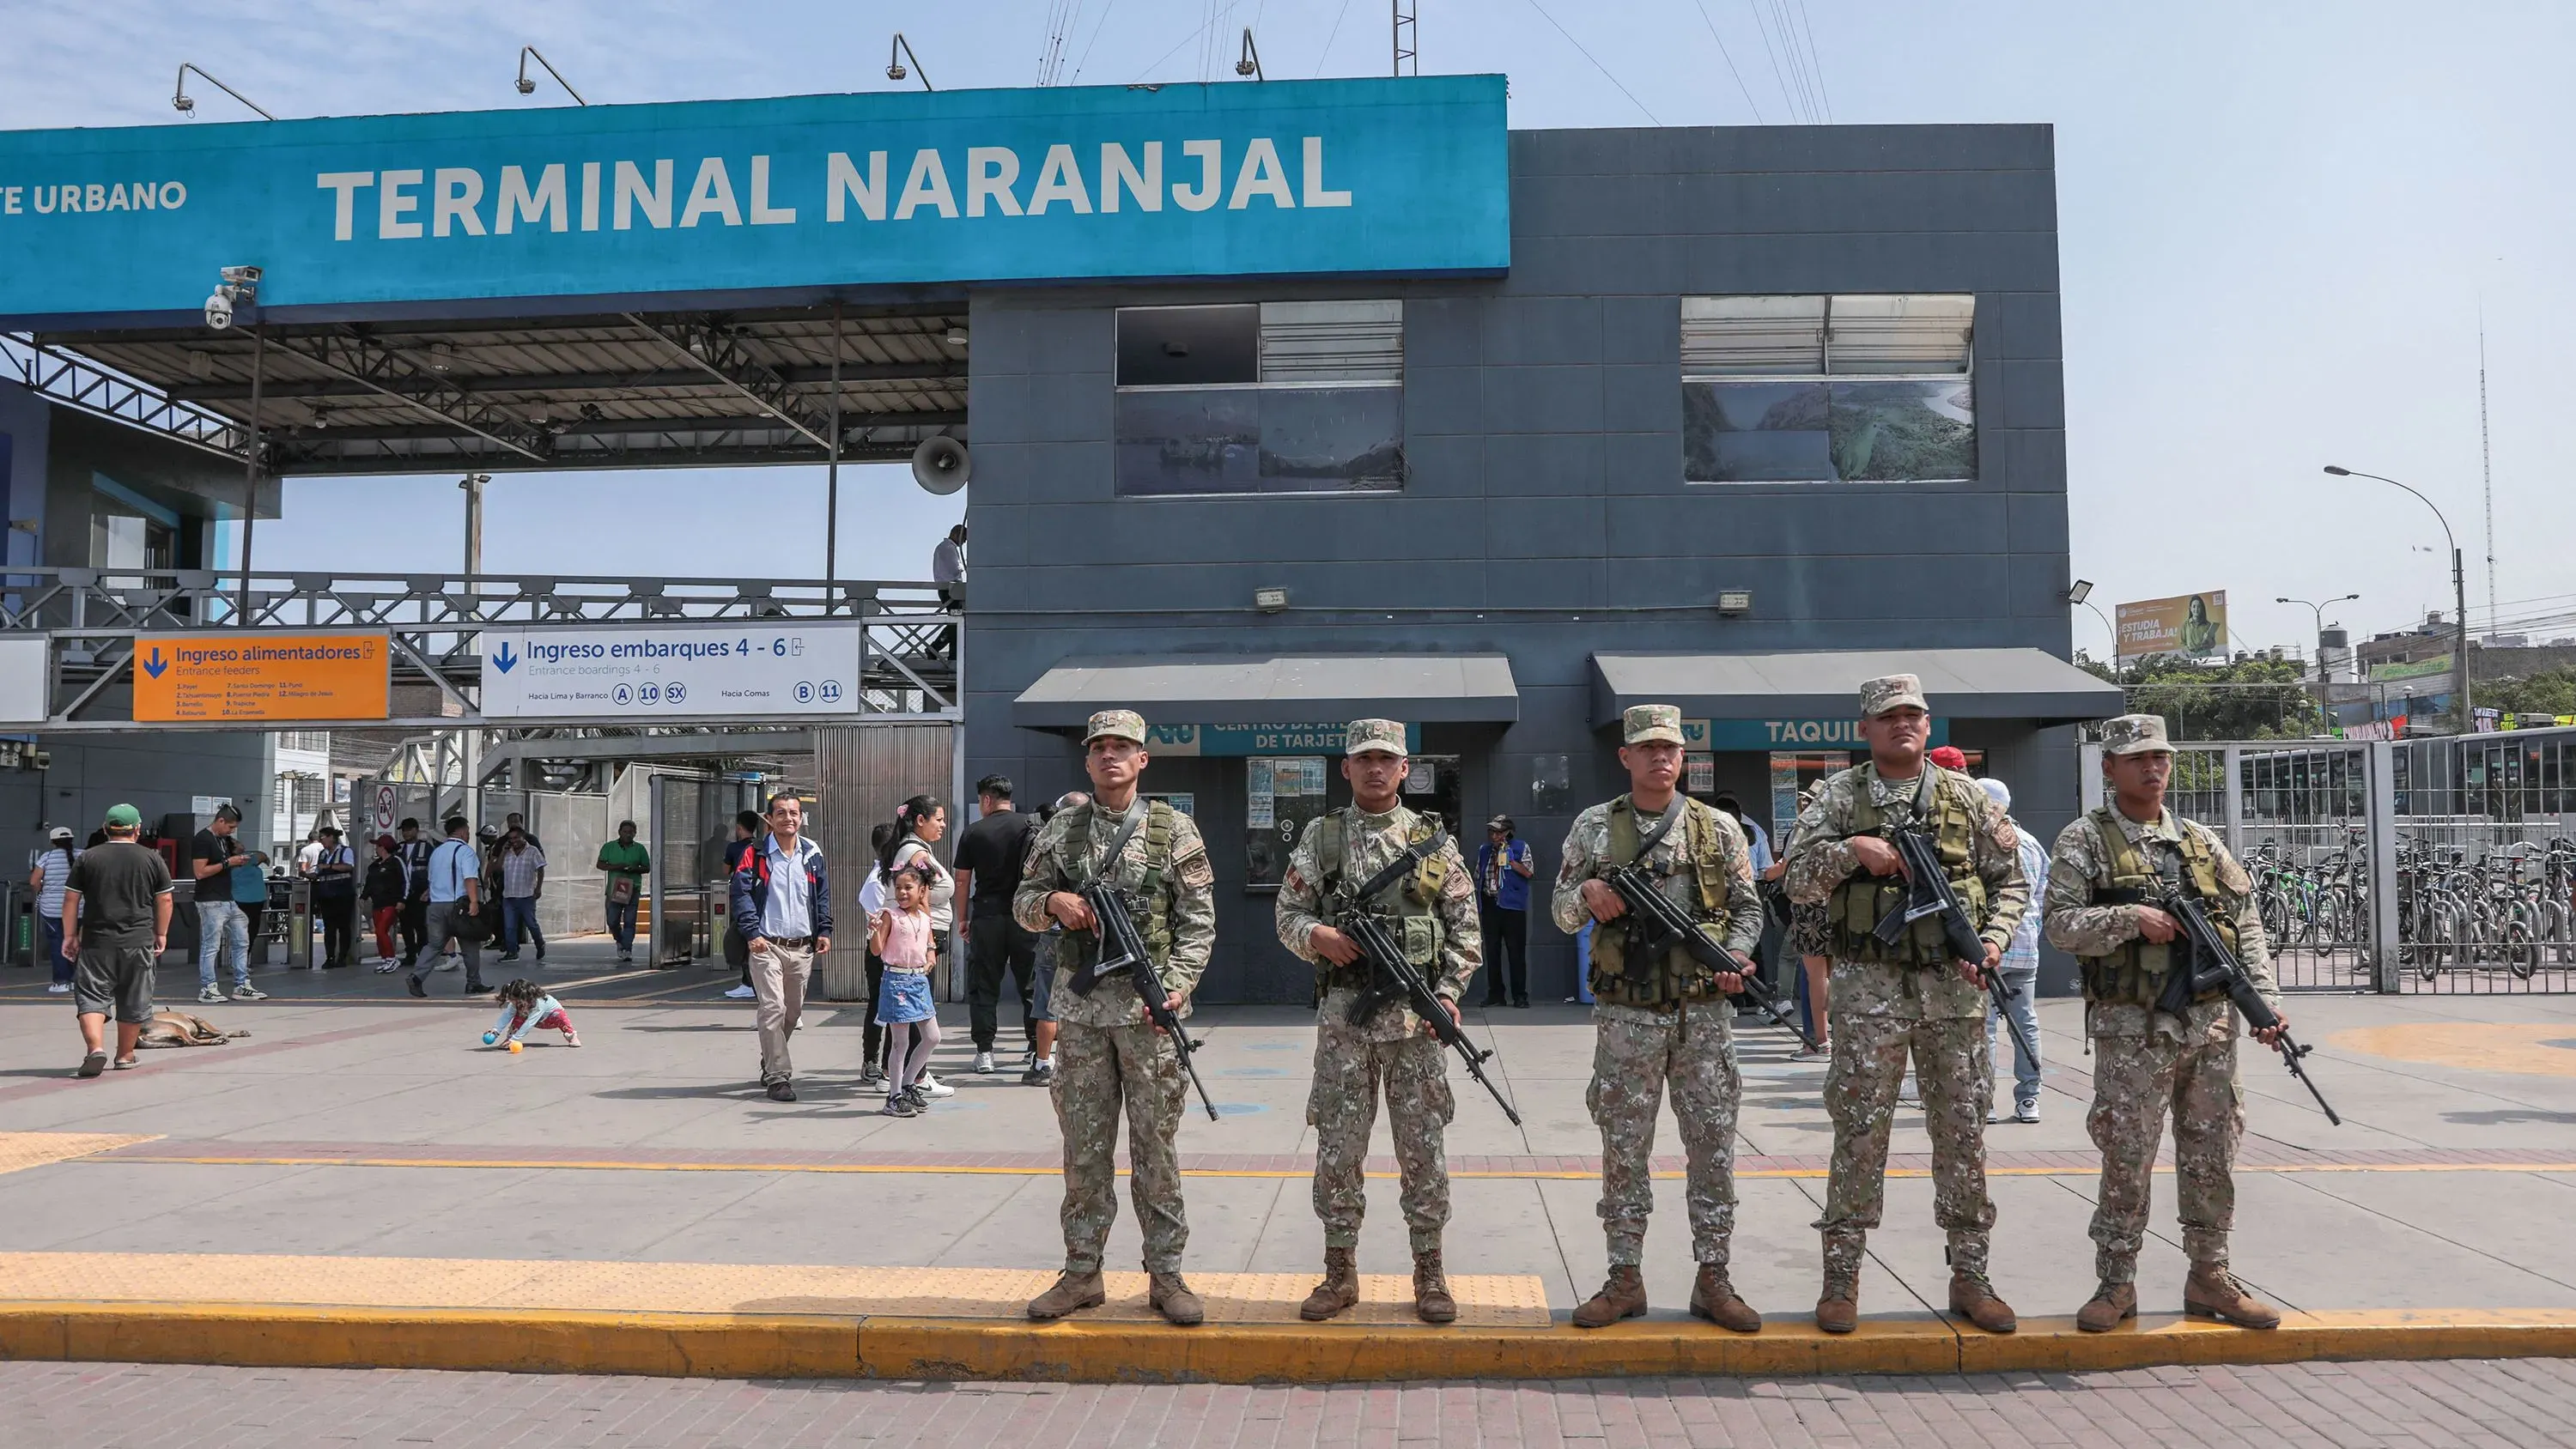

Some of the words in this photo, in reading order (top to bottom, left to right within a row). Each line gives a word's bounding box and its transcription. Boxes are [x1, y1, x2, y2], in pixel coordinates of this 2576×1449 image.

[317, 155, 797, 241] TERMINAL
[826, 136, 1352, 222] NARANJAL
[0, 186, 23, 215] E
[34, 180, 187, 214] URBANO
[2123, 633, 2131, 643] Y
[2132, 627, 2178, 642] TRABAJA!
[177, 646, 238, 665] Ingreso
[243, 645, 361, 660] alimentadores
[528, 641, 605, 663] Ingreso
[611, 640, 729, 662] embarques
[736, 639, 749, 656] 4
[773, 638, 786, 656] 6
[176, 666, 221, 676] Entrance
[224, 665, 260, 675] feeders
[529, 666, 575, 676] Entrance
[578, 664, 631, 676] boardings
[633, 664, 641, 675] 4
[653, 664, 660, 675] 6
[617, 688, 628, 700] A
[641, 687, 659, 700] 10
[667, 687, 683, 699] SX
[799, 686, 809, 698] B
[822, 685, 839, 697] 11
[1765, 721, 1867, 742] TAQUIL
[1256, 734, 1279, 748] DE
[1282, 733, 1346, 748] TARJET
